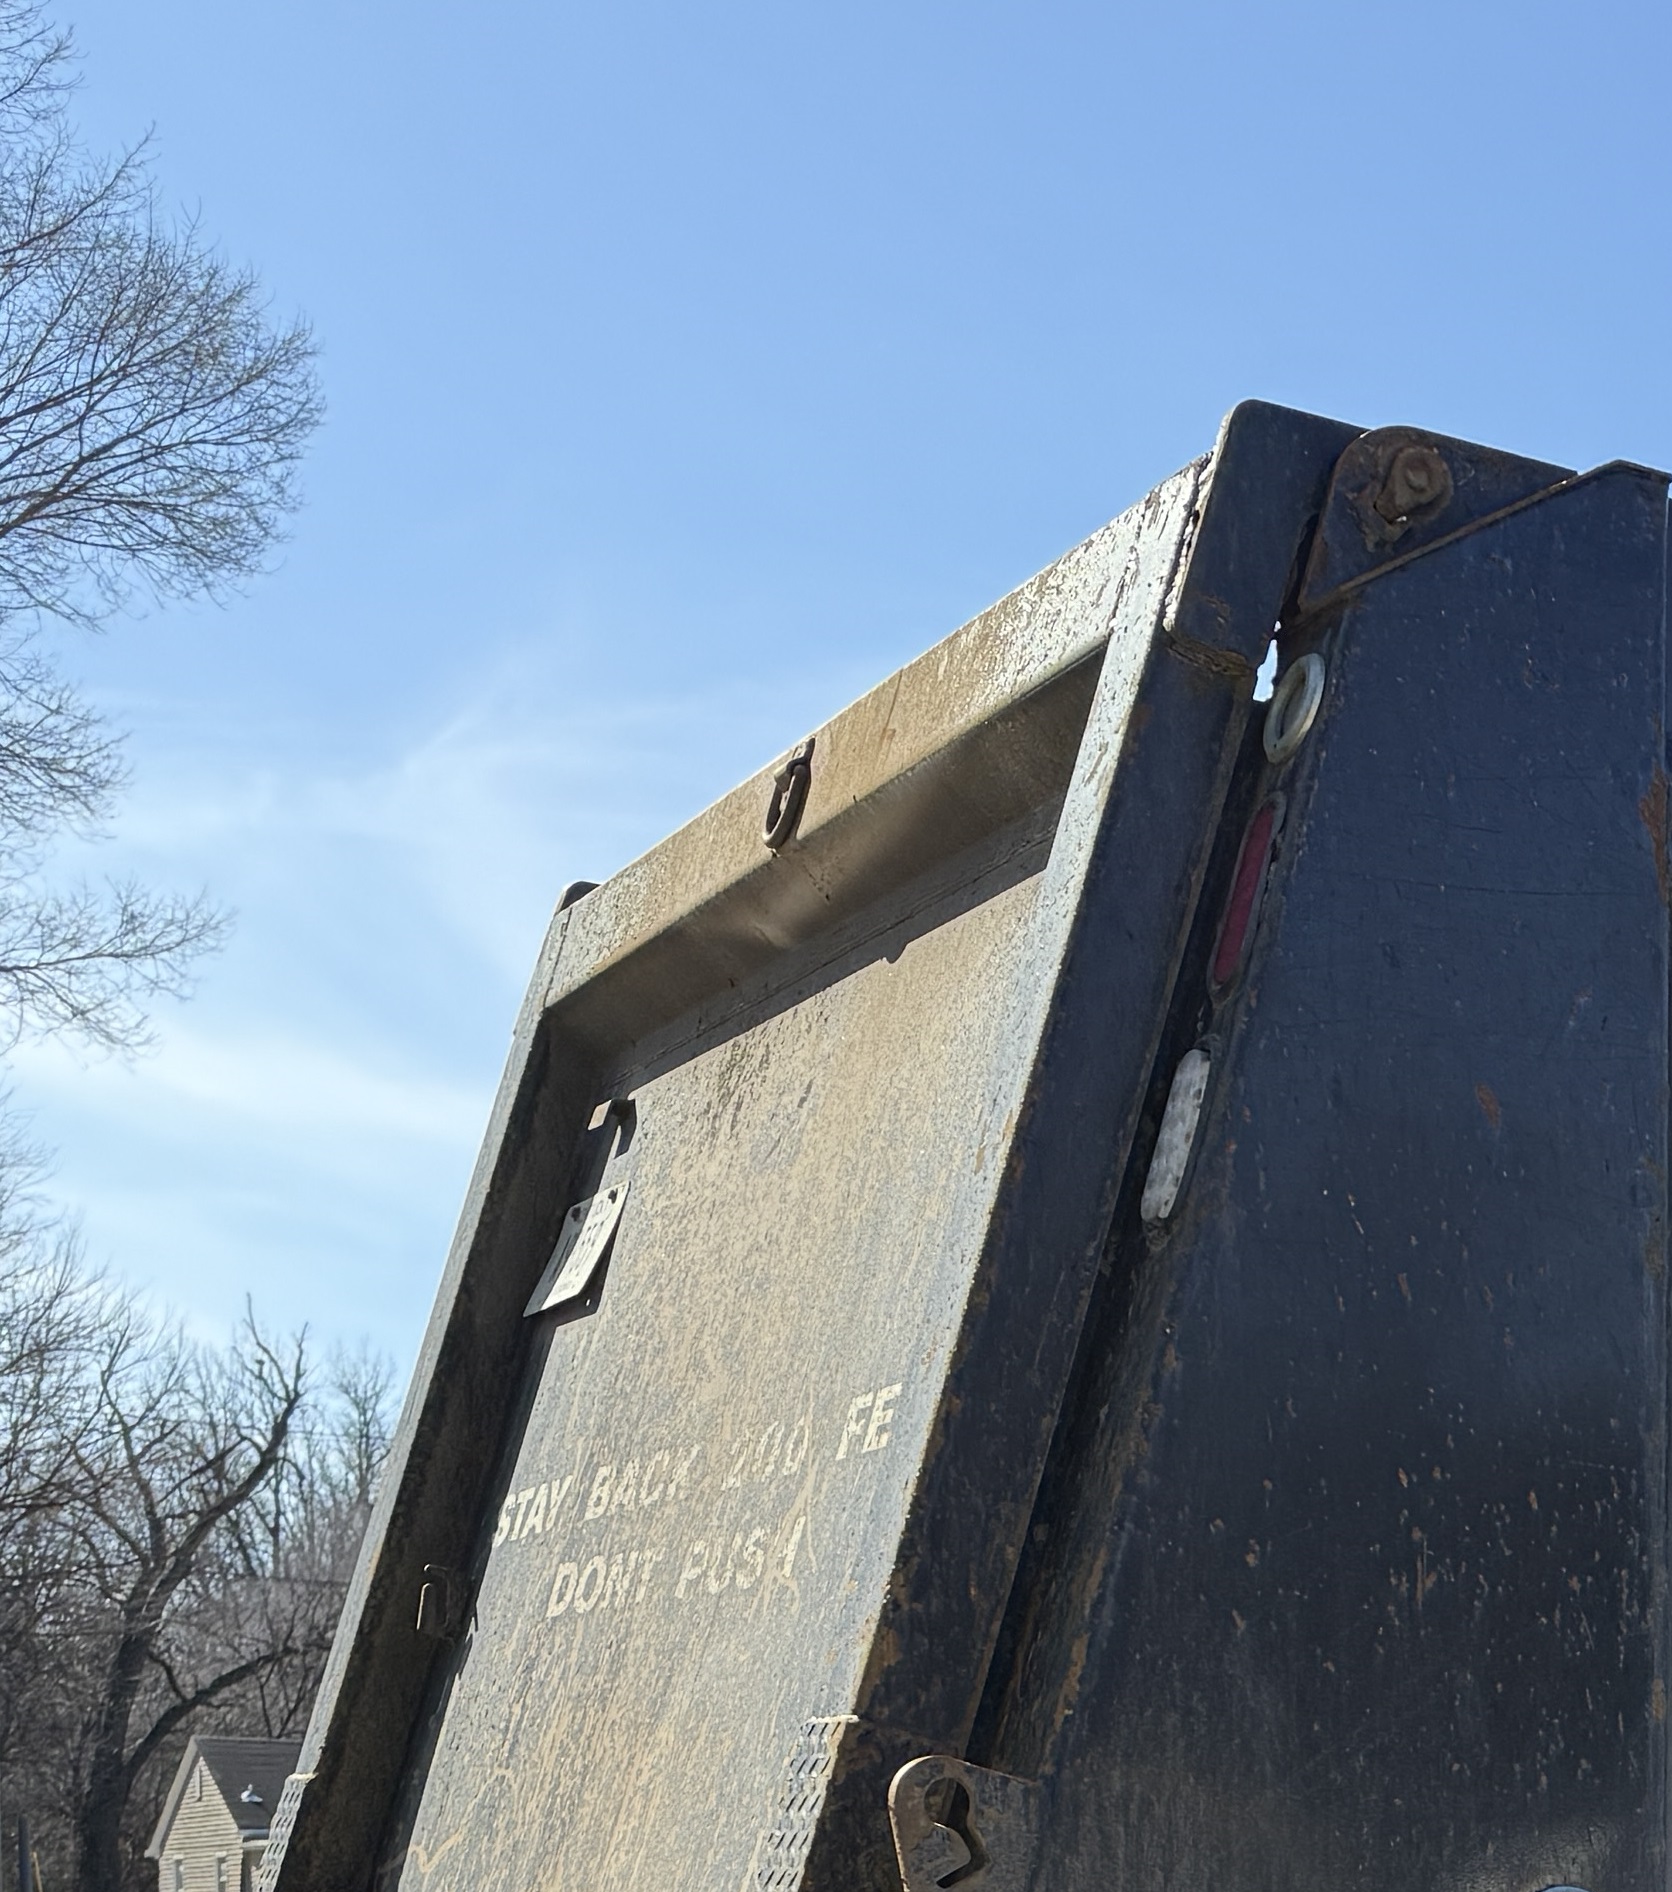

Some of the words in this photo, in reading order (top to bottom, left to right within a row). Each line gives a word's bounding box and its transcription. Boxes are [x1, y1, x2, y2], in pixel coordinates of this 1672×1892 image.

[493, 1474, 573, 1548] STAY
[582, 1445, 701, 1522] BACK
[545, 1547, 664, 1619] DONT
